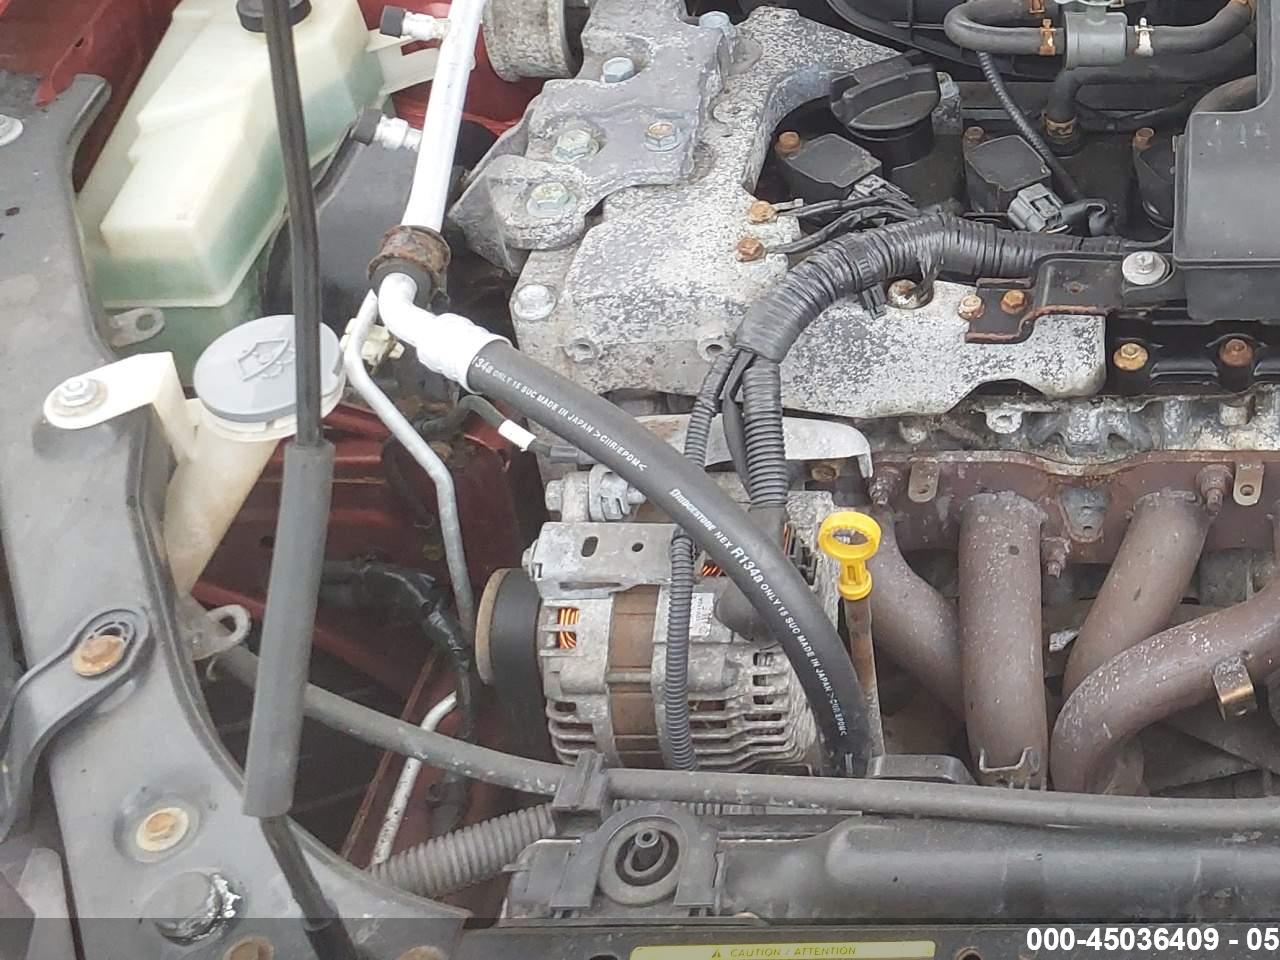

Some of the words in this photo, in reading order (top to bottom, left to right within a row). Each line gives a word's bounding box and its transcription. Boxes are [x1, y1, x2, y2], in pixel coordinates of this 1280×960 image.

[536, 394, 558, 412] MADE
[557, 407, 569, 417] IN
[567, 414, 594, 435] JAPAN
[730, 545, 763, 584] R134a
[760, 581, 781, 607] ONLY
[796, 634, 815, 658] MADE
[808, 657, 820, 669] IN
[815, 667, 833, 693] JAPAN
[730, 948, 781, 958] CAUTION
[794, 946, 856, 957] ATTENTION
